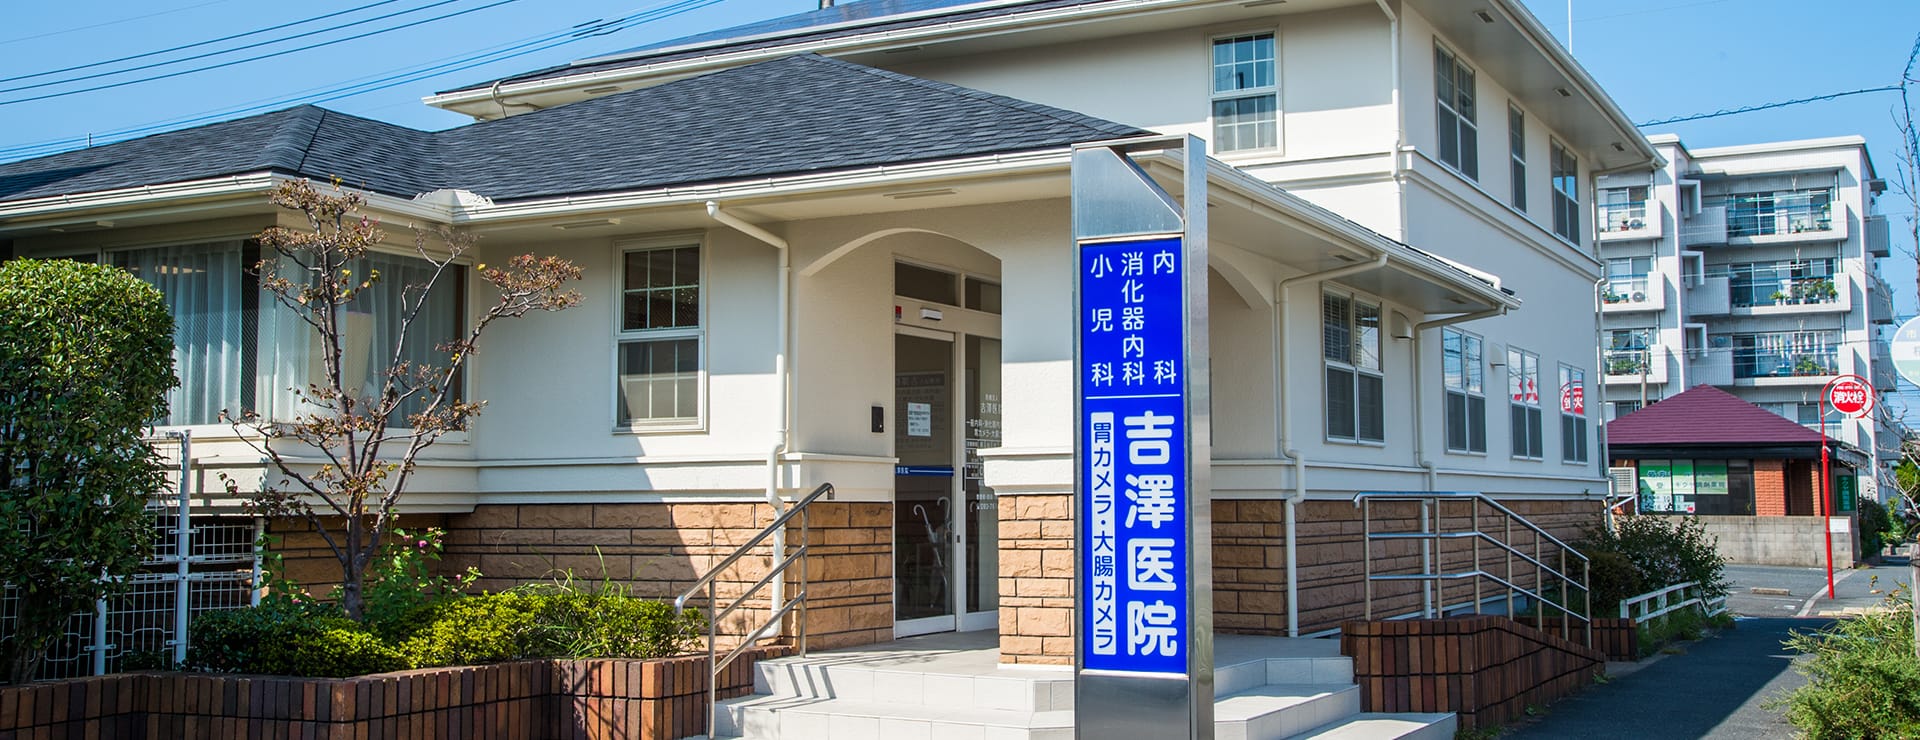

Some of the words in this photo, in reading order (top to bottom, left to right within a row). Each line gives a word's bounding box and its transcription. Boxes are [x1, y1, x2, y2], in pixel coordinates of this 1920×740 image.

[1091, 253, 1114, 387] 小児科
[1121, 251, 1145, 386] 消化器内科
[1153, 250, 1177, 385] 内科
[1833, 391, 1865, 404] 消火栓
[1093, 422, 1114, 649] 胃カメラ・大腸カメラ
[1123, 410, 1178, 657] 吉澤医院
